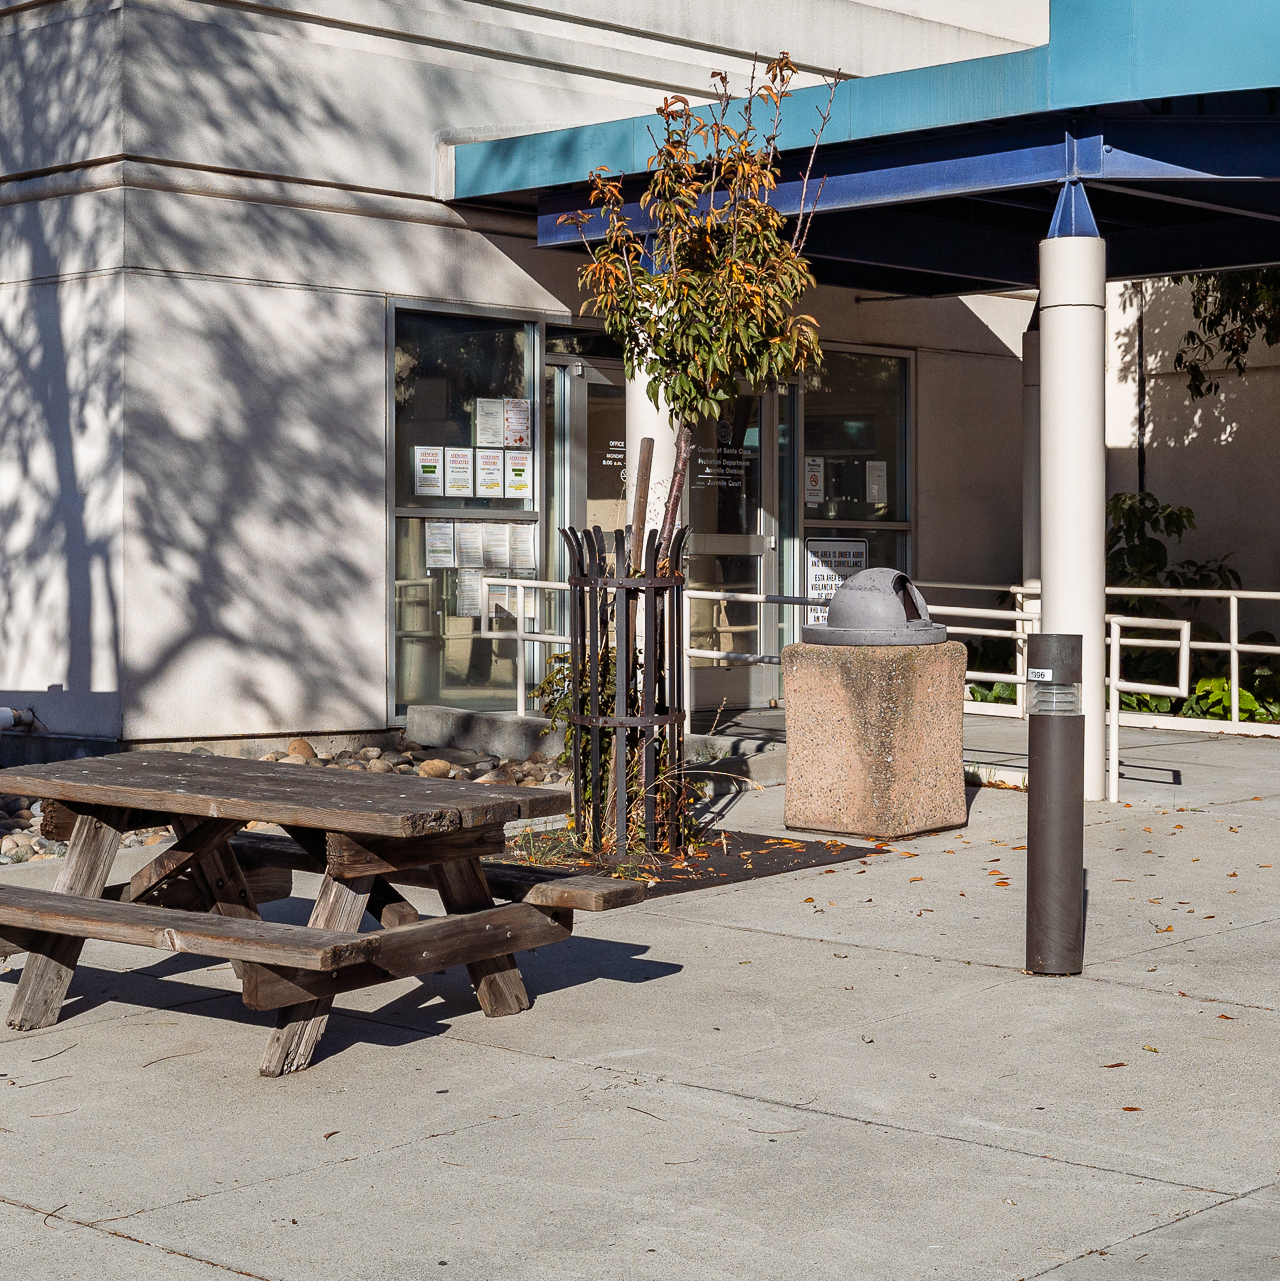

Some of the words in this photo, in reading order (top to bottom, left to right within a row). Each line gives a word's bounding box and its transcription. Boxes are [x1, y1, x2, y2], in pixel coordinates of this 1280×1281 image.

[810, 550, 819, 558] THIS
[821, 550, 831, 558] AREA
[832, 550, 837, 558] IS
[834, 560, 862, 568] SURVEILLANCE
